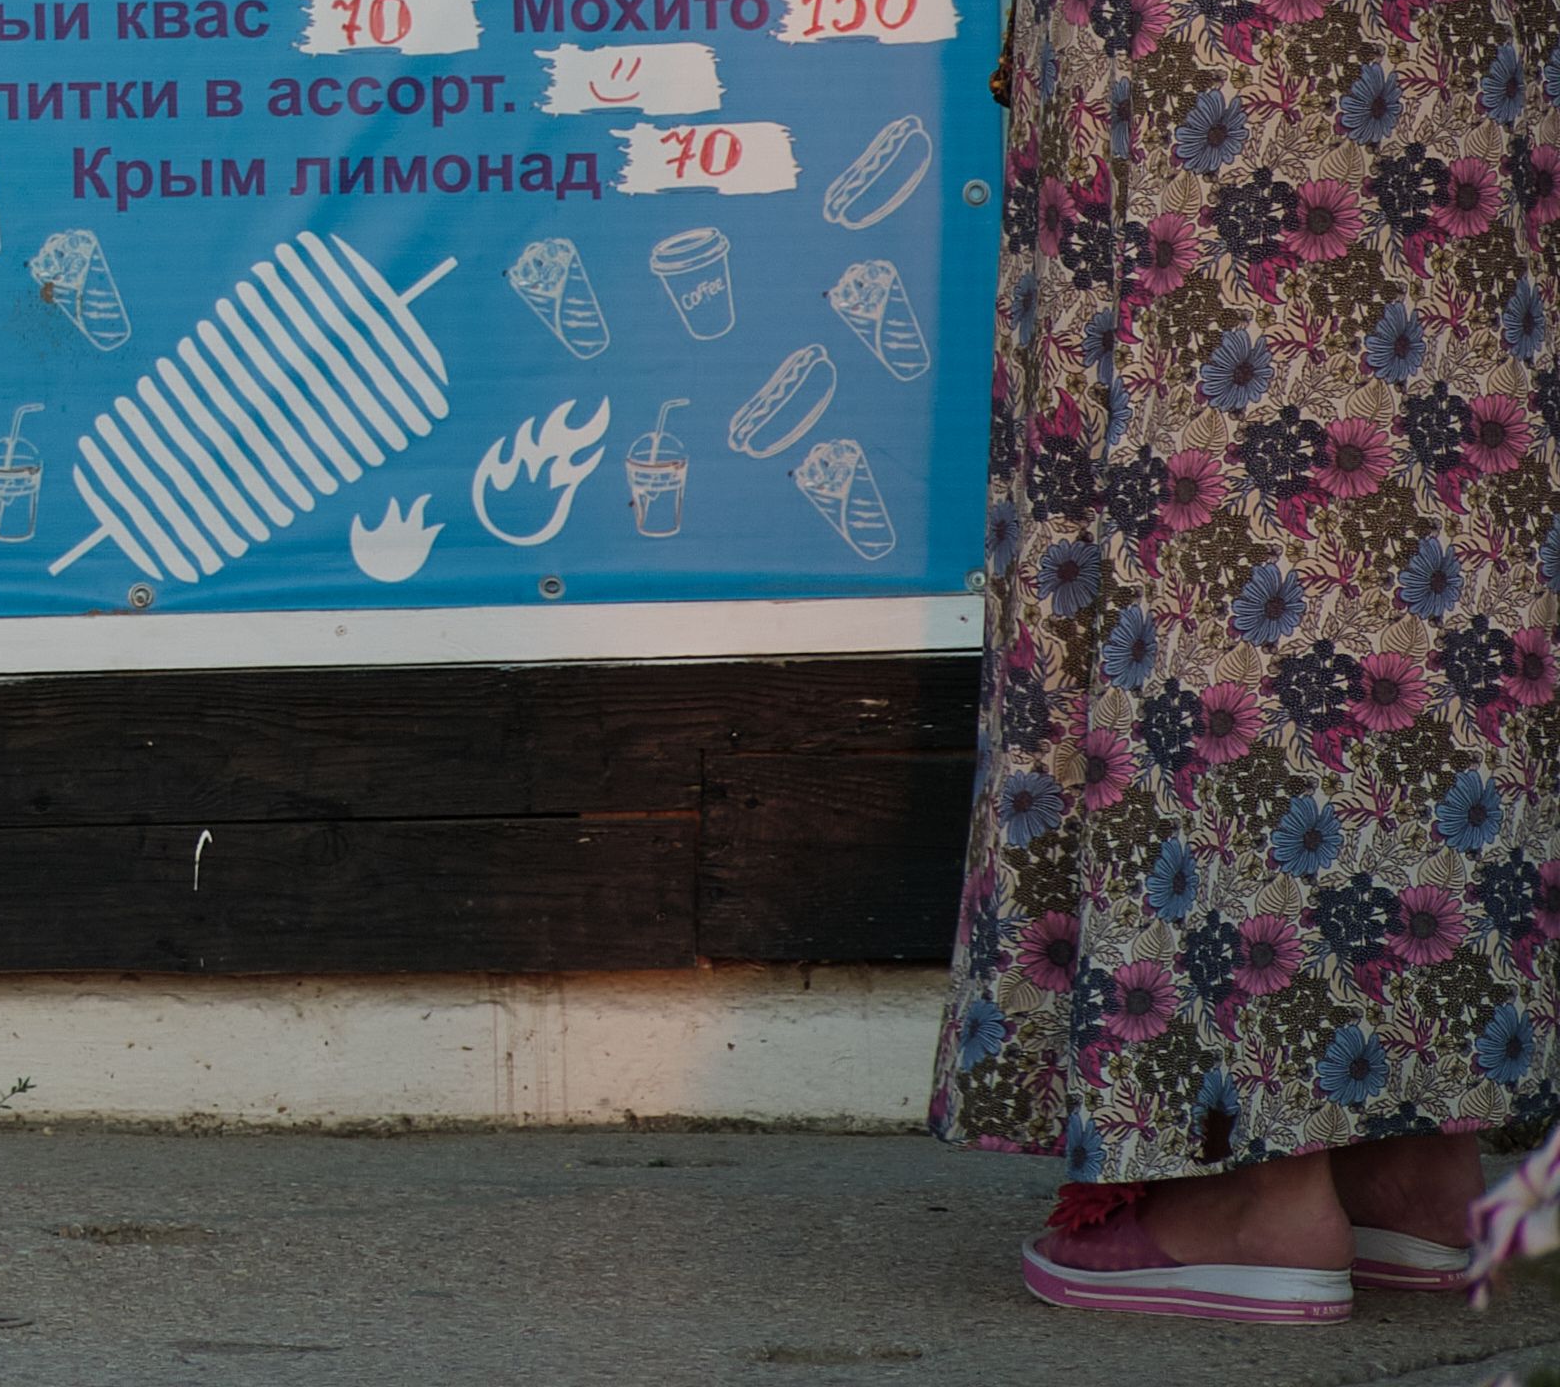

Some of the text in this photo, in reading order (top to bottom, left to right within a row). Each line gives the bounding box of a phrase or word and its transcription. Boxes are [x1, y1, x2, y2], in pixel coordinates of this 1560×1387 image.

[204, 69, 246, 115] в
[266, 64, 517, 131] ассорт.
[70, 129, 742, 213] Крым лимонад 70
